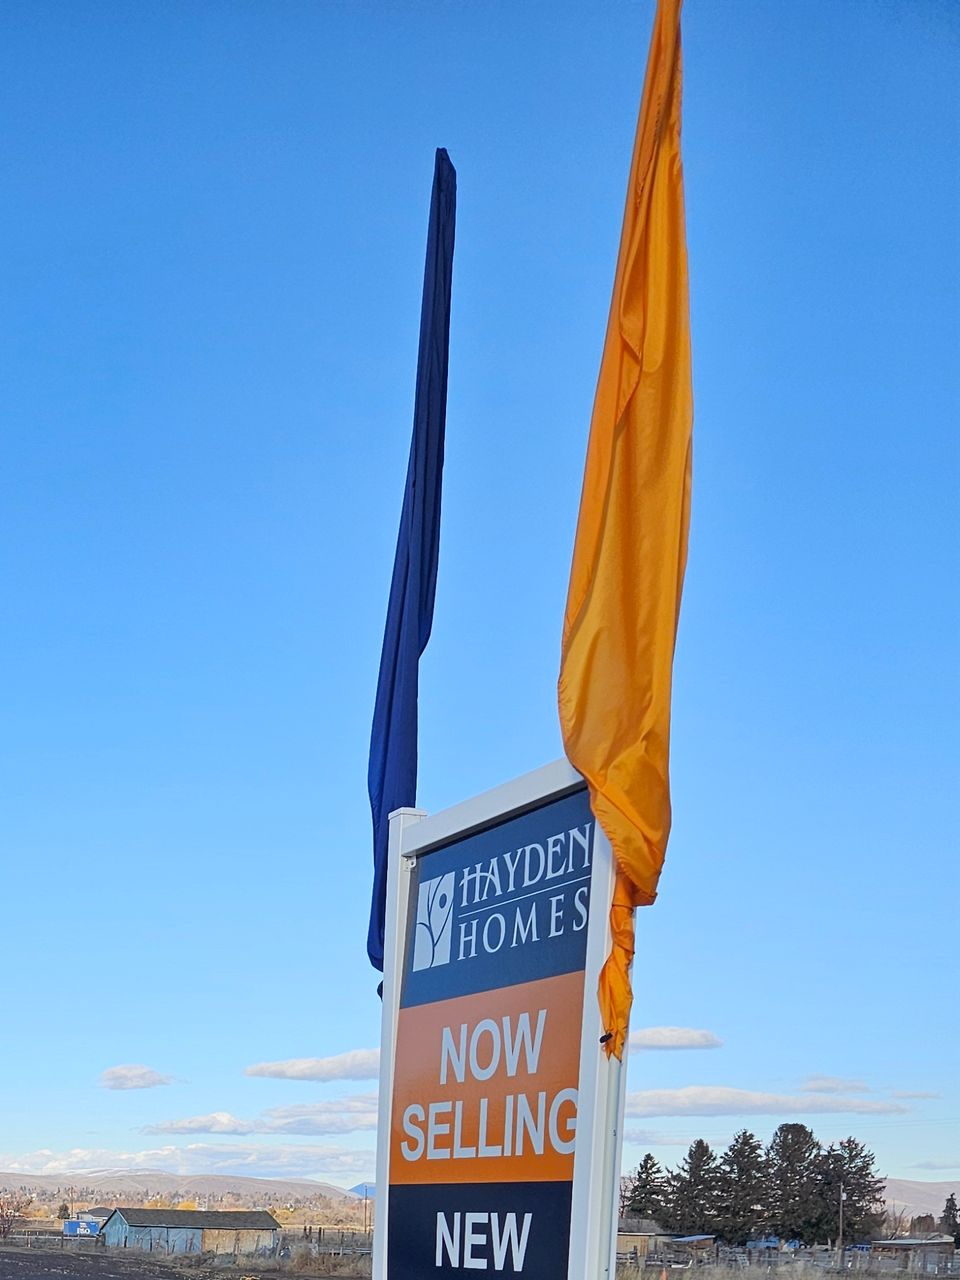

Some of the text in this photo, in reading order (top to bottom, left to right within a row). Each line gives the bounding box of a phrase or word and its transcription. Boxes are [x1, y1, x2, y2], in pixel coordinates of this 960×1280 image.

[459, 822, 592, 907] HAYDEN
[457, 886, 588, 961] HOMES
[440, 1009, 547, 1085] NOW
[400, 1087, 578, 1161] SELLING
[435, 1211, 532, 1272] NEW
